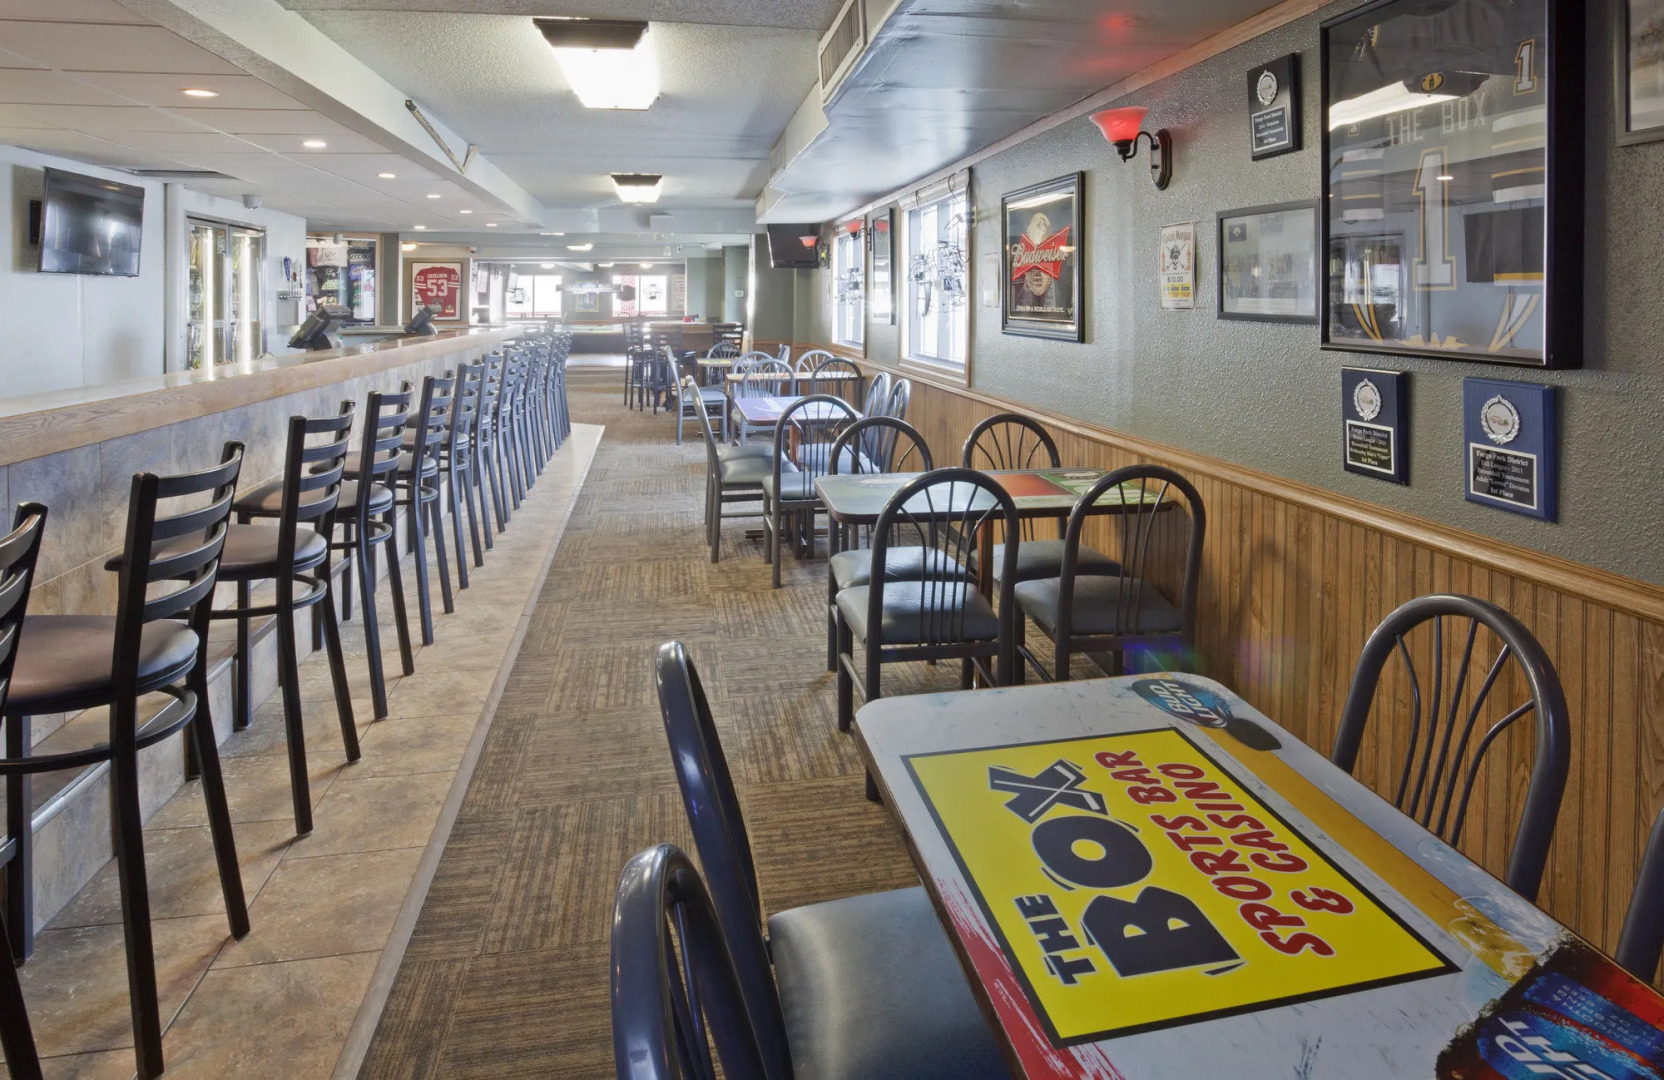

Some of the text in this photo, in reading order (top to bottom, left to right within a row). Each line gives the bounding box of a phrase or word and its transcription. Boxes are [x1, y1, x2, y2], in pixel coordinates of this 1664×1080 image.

[1513, 38, 1537, 96] 1
[1387, 107, 1425, 146] THE
[1441, 91, 1487, 136] BOX
[1411, 145, 1457, 291] 1
[1011, 242, 1069, 268] Budweiser
[426, 278, 448, 297] 53
[1167, 275, 1184, 283] $10.00
[1476, 450, 1528, 467] Fargo Park District
[1491, 462, 1506, 471] League
[1499, 489, 1514, 498] Place
[1502, 473, 1529, 484] Tournament
[1509, 483, 1529, 493] Division
[1149, 684, 1194, 714] BUD
[1158, 680, 1220, 719] LIGHT
[1094, 750, 1335, 958] SPORTS BAR
[1156, 762, 1356, 916] & CASINO
[988, 757, 1243, 977] BOX
[1013, 893, 1096, 986] THE
